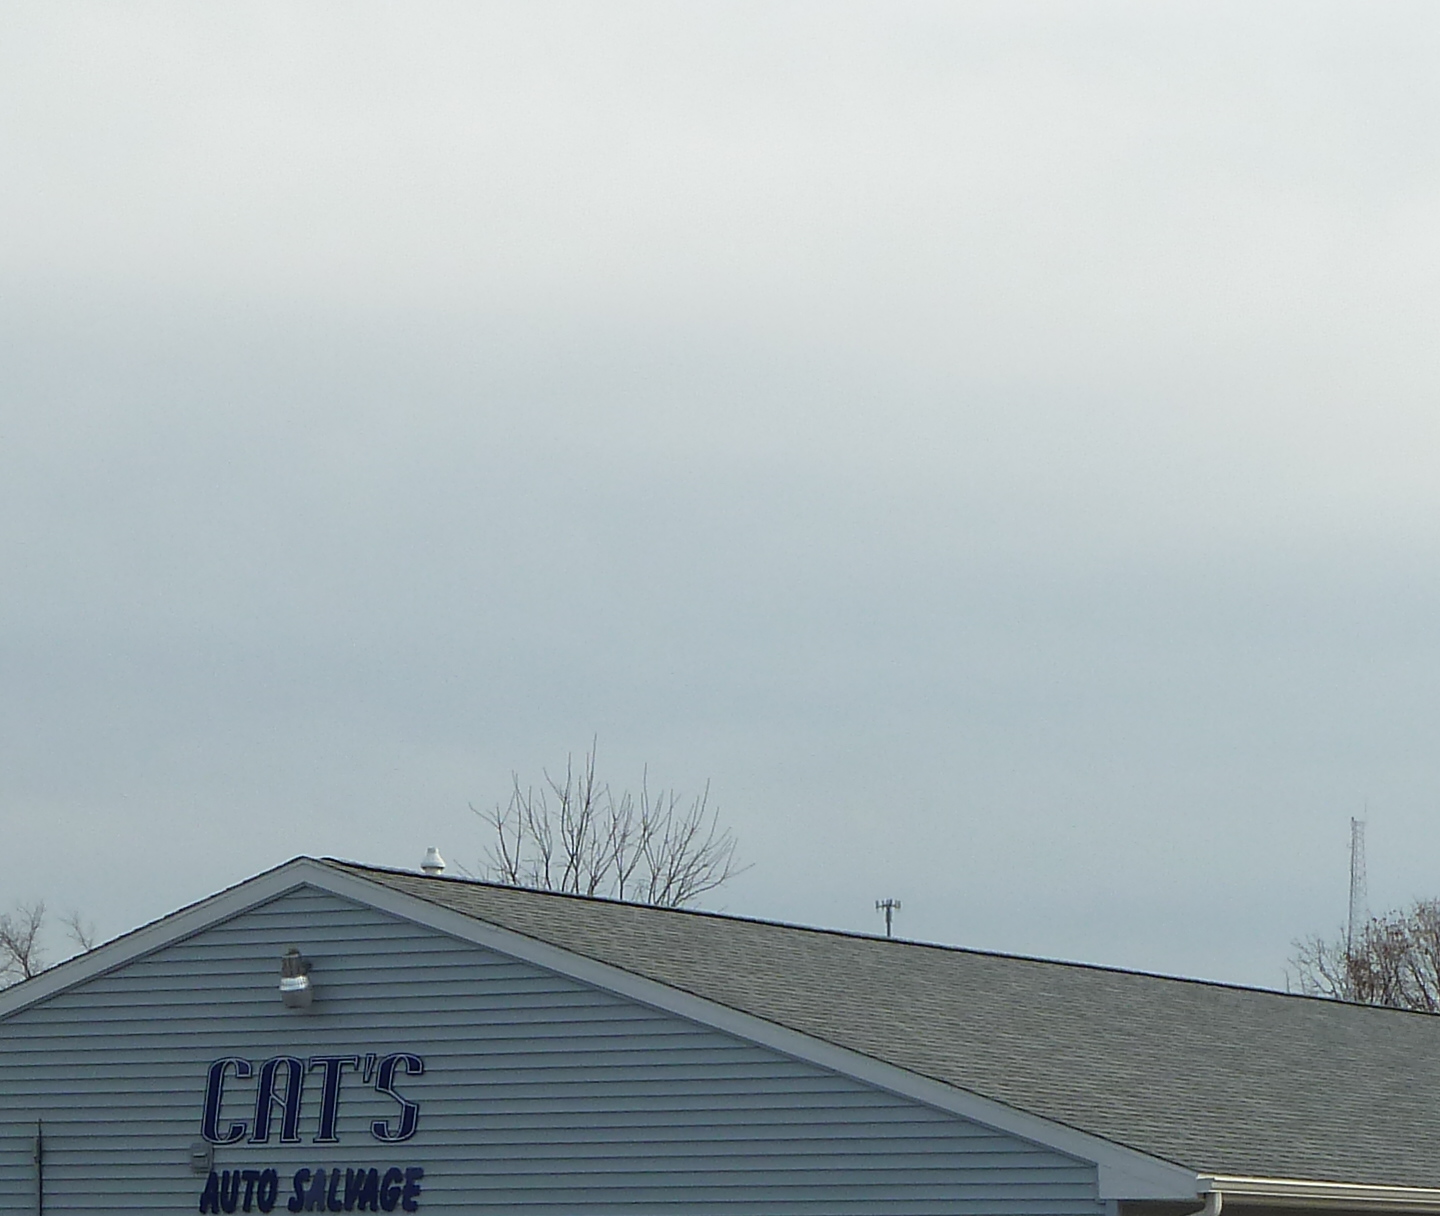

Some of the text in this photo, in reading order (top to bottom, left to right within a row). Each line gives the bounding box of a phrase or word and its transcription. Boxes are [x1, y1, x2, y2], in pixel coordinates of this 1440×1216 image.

[201, 1053, 424, 1145] CAT'S
[199, 1167, 424, 1214] AUTO SALVAGE
